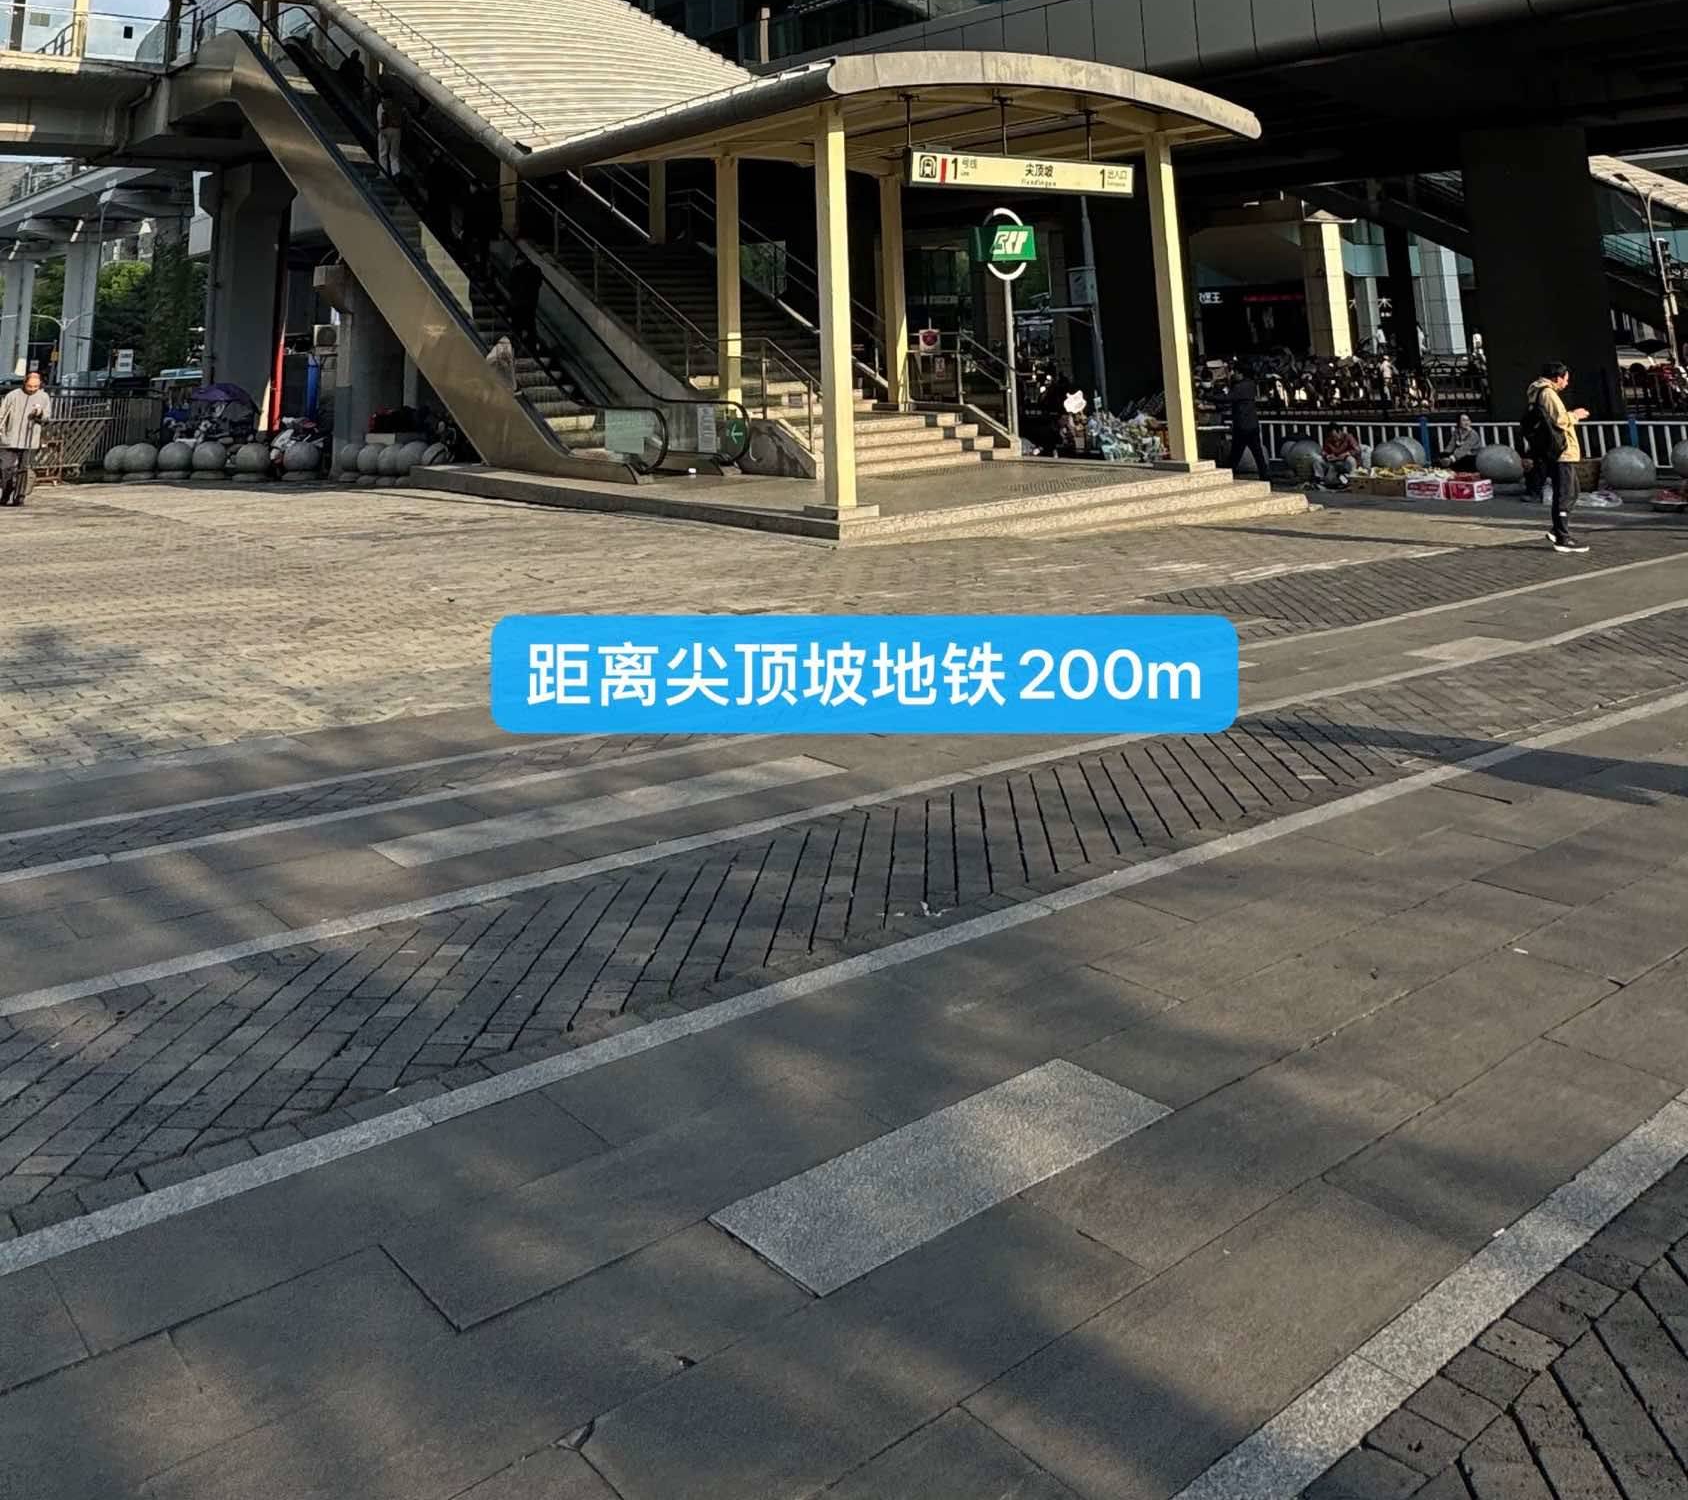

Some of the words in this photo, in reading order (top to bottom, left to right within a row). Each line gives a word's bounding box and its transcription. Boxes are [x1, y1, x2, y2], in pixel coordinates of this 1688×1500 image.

[951, 157, 958, 180] 1
[1024, 162, 1054, 178] 尖顶坡
[1107, 168, 1128, 180] 出入口
[1099, 168, 1105, 189] 1
